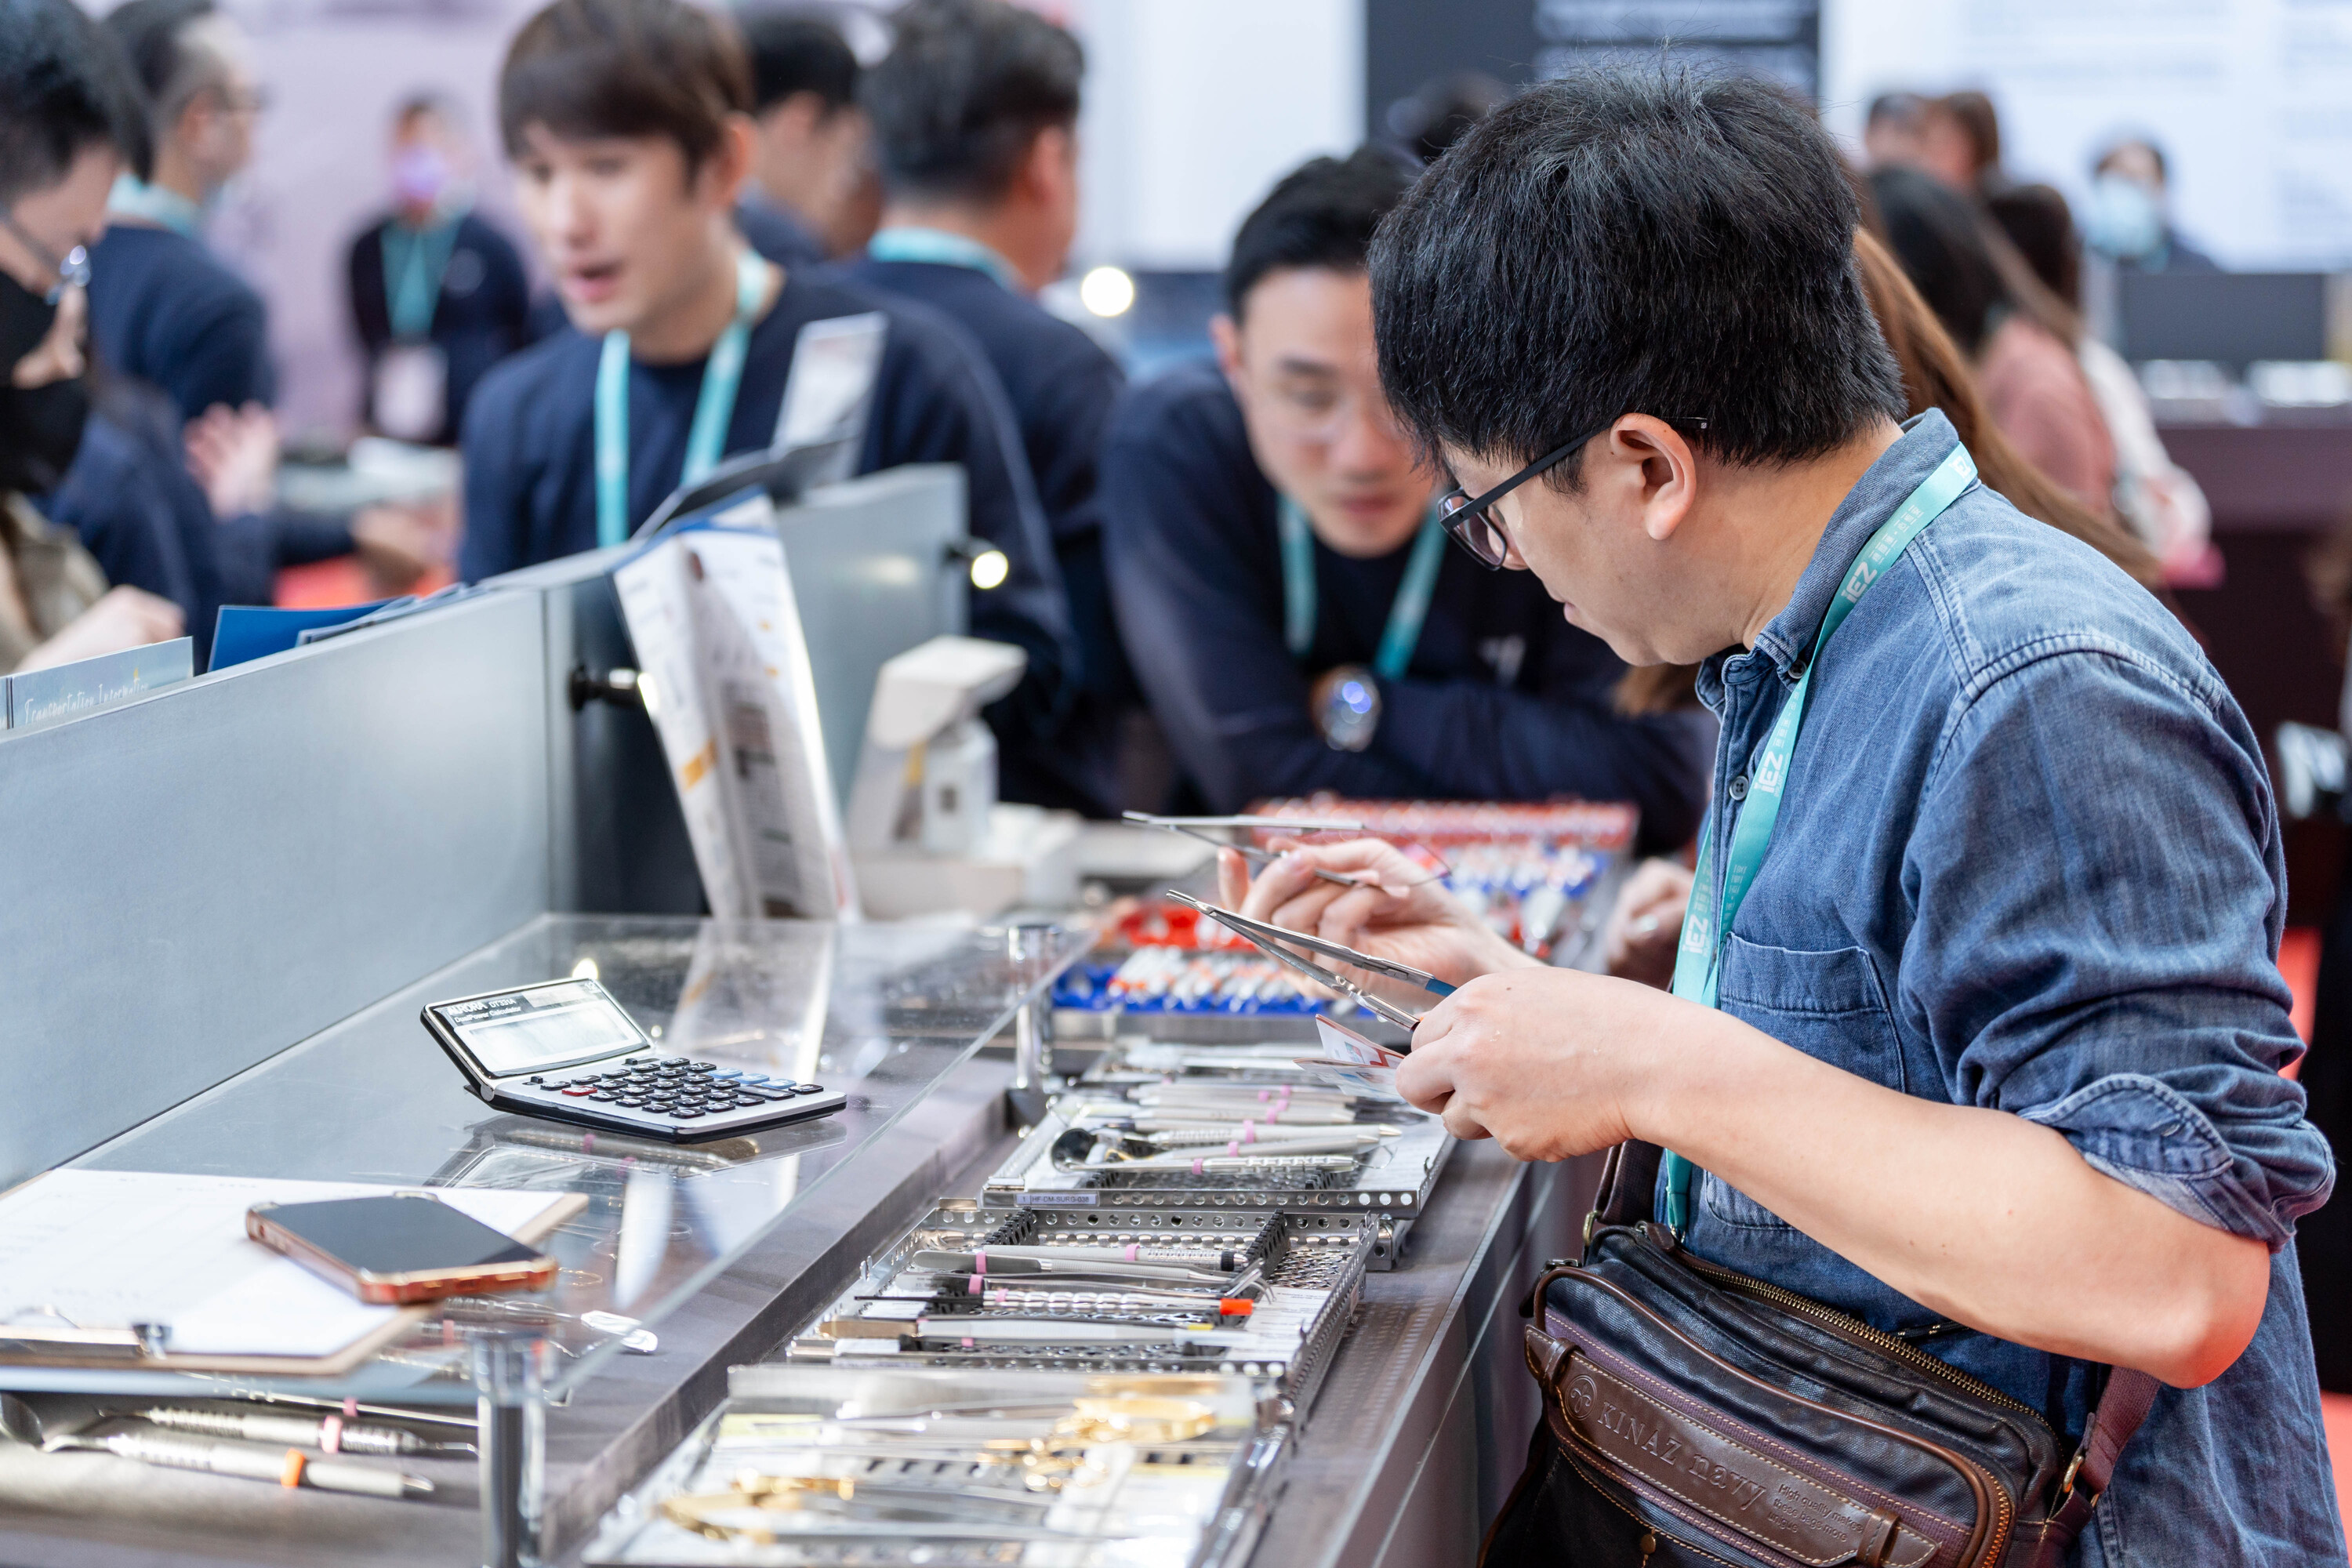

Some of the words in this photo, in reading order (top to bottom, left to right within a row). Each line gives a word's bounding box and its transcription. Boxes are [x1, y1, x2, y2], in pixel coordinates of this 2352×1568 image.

[1597, 1401, 1682, 1465] KINAZ
[1688, 1454, 1767, 1510] navy
[1778, 1483, 1801, 1501] High
[1802, 1497, 1833, 1518] quality
